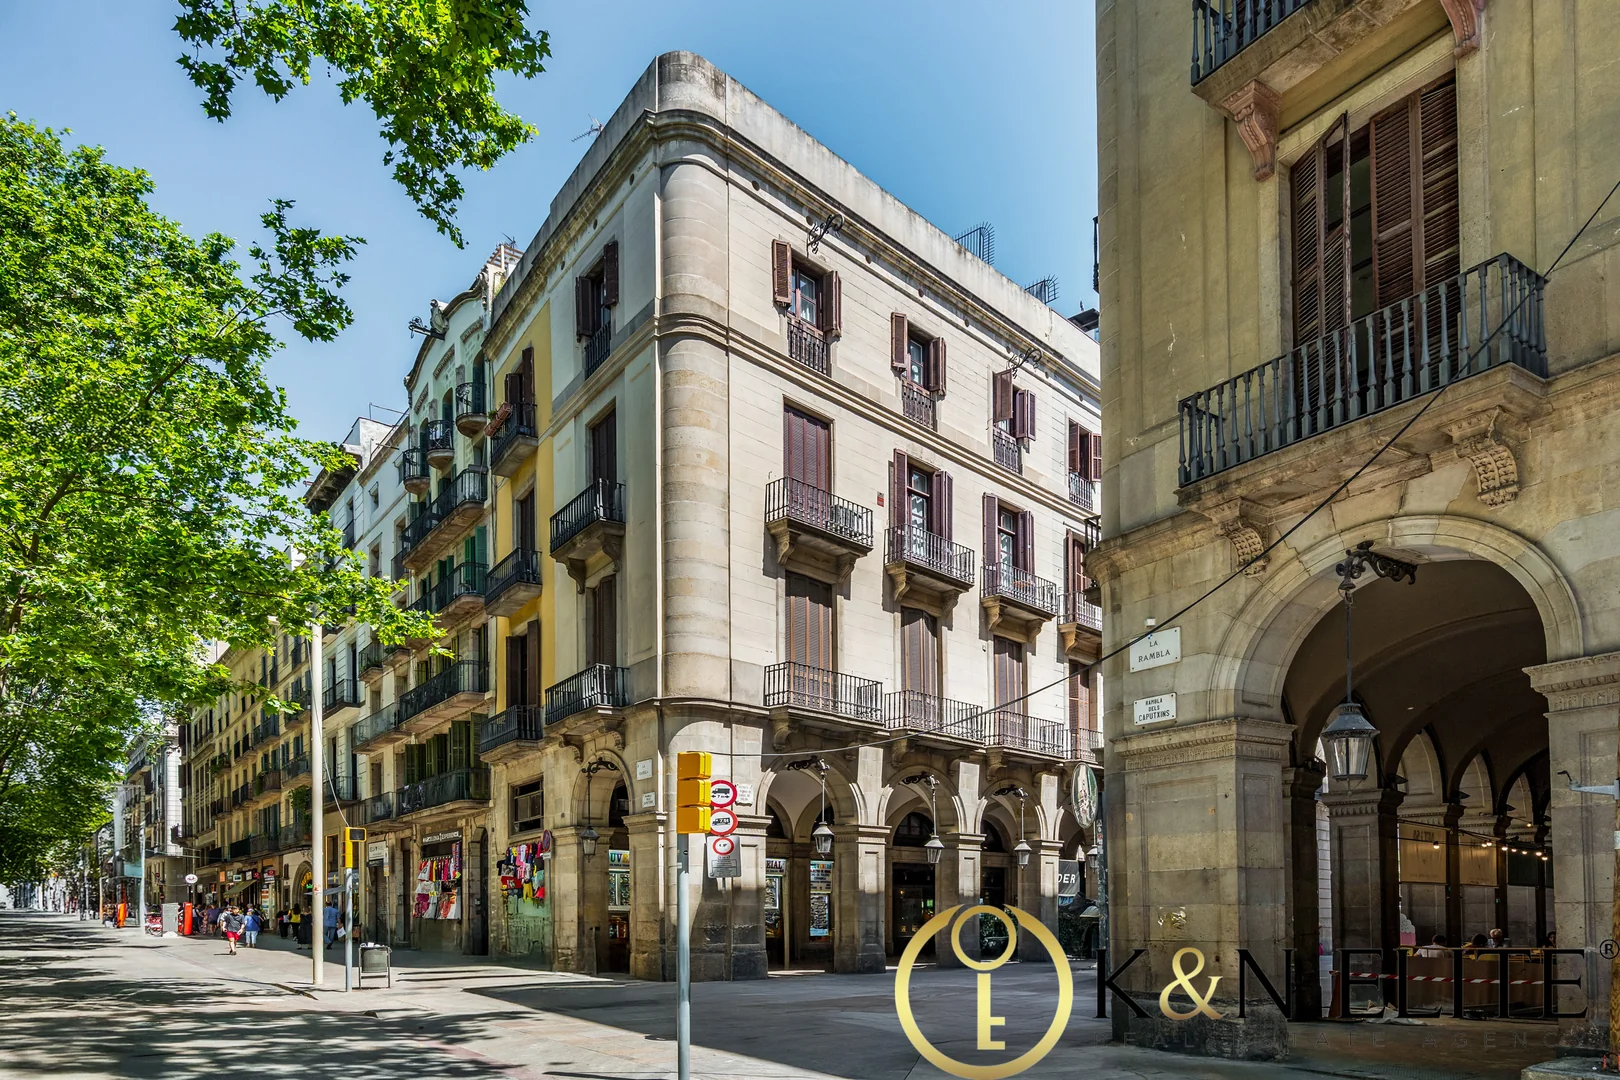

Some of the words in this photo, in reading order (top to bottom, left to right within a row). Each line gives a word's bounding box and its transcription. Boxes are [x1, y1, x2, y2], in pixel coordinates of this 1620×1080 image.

[1138, 650, 1170, 662] RAMBLA
[1145, 697, 1163, 706] RAMBLA
[1138, 710, 1170, 721] CAPUTXINS
